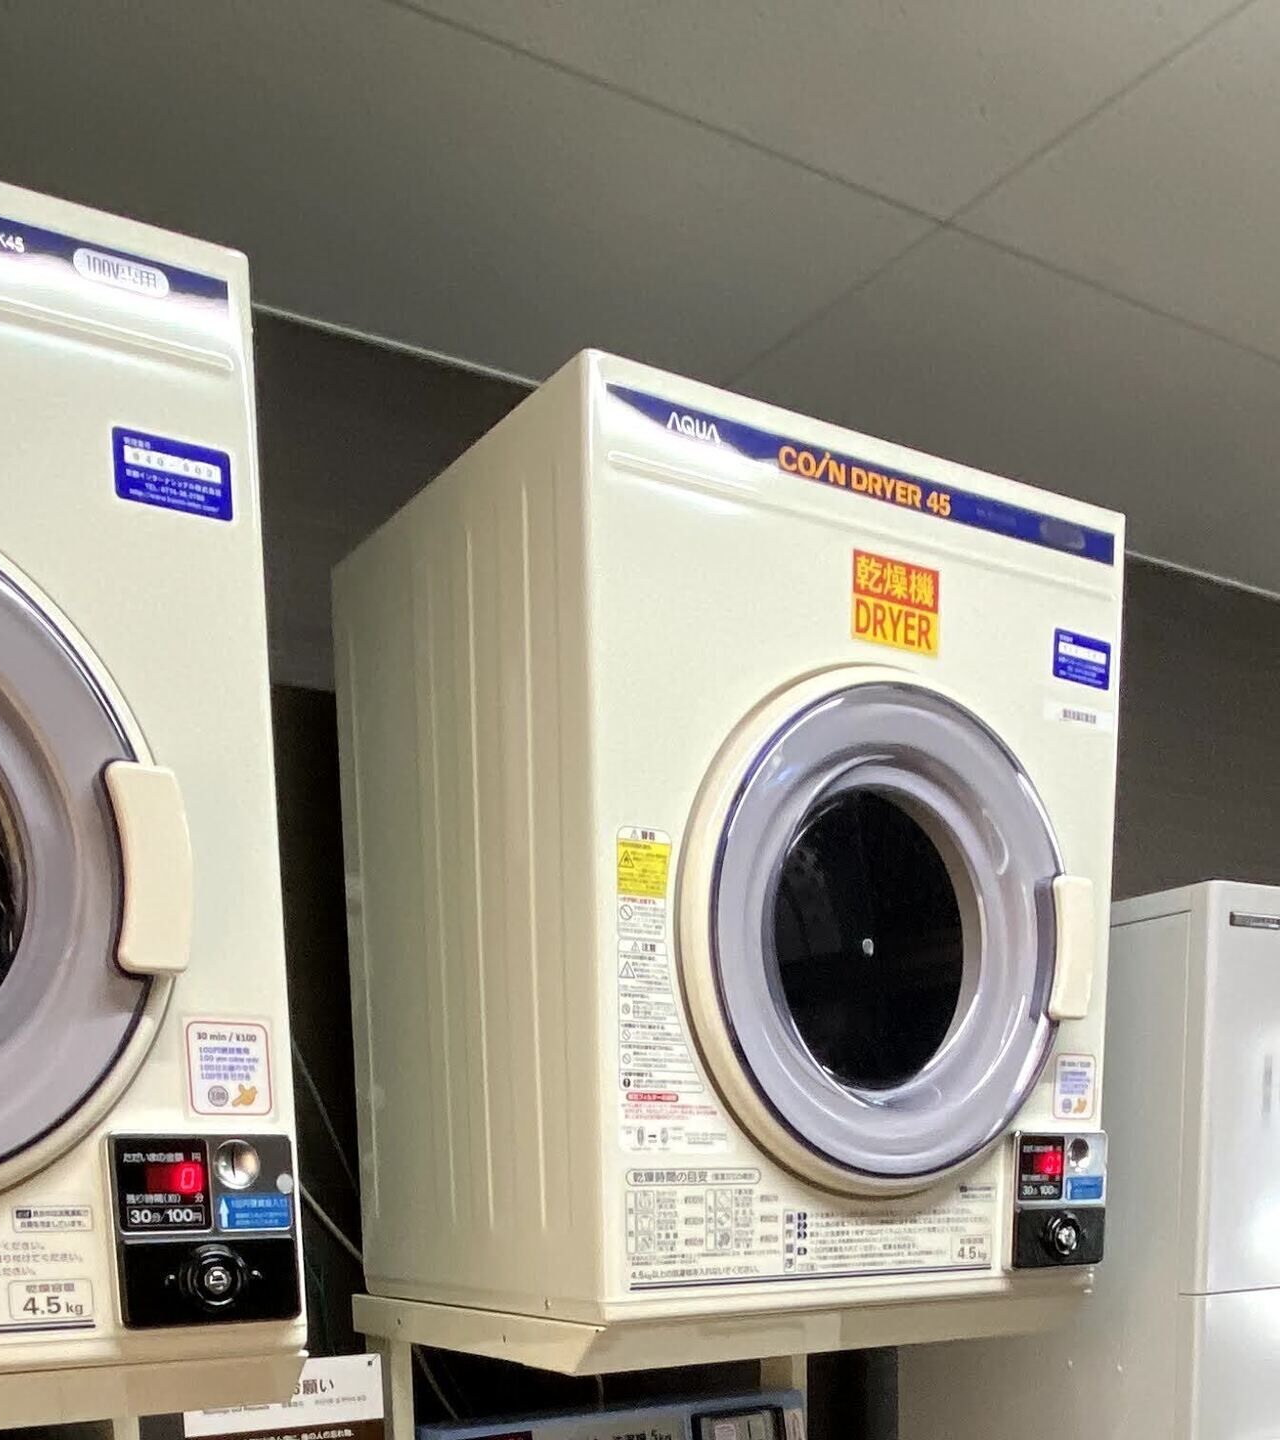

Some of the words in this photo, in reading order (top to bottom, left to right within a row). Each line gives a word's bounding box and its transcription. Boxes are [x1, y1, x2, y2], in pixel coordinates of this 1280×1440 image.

[665, 410, 721, 442] AQUA
[778, 445, 847, 486] COIN
[849, 467, 922, 509] DRYER
[925, 490, 952, 516] 45
[854, 555, 935, 608] 乾燥機
[853, 598, 932, 650] DRYER
[180, 1167, 195, 1190] 0
[957, 1245, 977, 1261] 4.5
[22, 1295, 62, 1316] 4.5
[65, 1300, 84, 1316] kg
